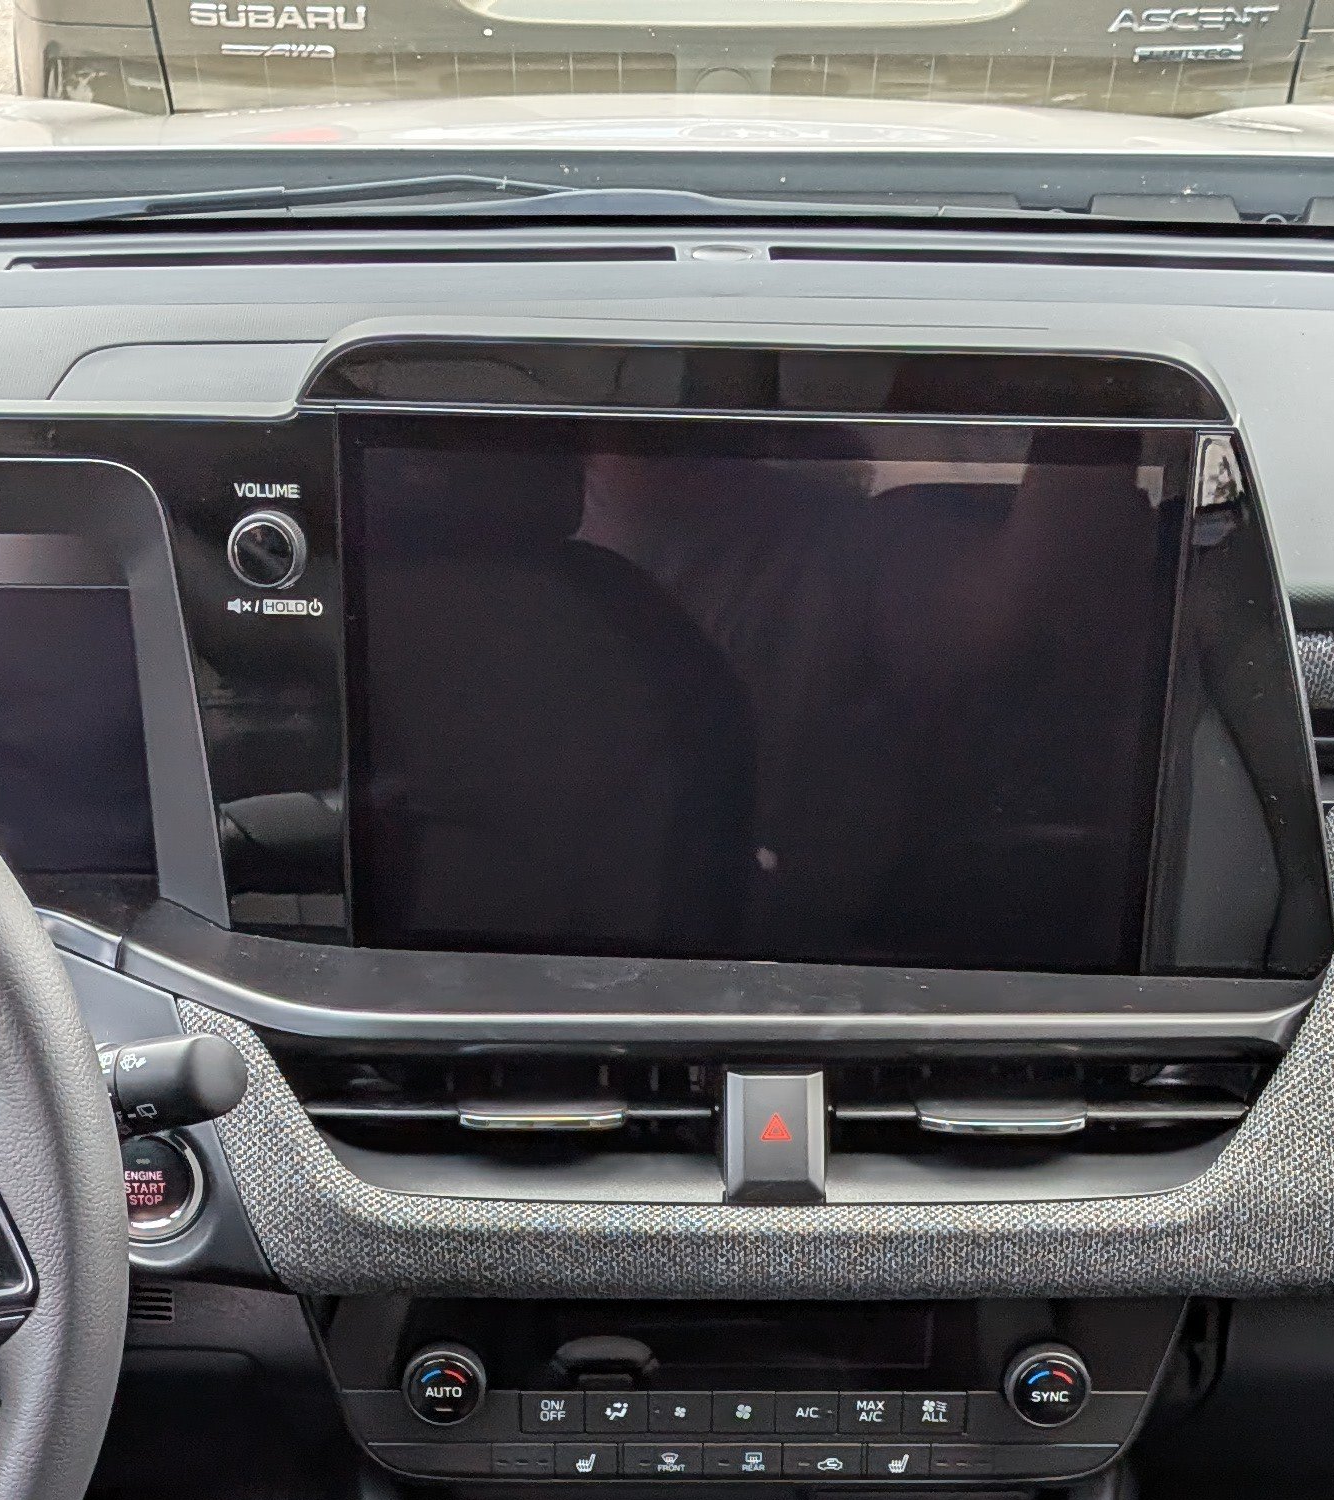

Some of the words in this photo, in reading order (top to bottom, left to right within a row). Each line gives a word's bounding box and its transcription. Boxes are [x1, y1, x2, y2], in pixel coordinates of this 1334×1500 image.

[189, 3, 366, 30] SUBARU
[1108, 5, 1279, 32] ASCENT
[233, 482, 301, 499] VOLUME
[264, 600, 306, 614] HOLD
[124, 1170, 163, 1181] ENGINE
[124, 1182, 166, 1194] START
[129, 1194, 163, 1206] STOP
[425, 1386, 463, 1398] AUTO
[1031, 1390, 1069, 1403] SYNC
[540, 1399, 565, 1411] ON/
[856, 1400, 886, 1411] MAX
[539, 1410, 566, 1422] OFF
[795, 1407, 819, 1418] A/C
[858, 1411, 883, 1423] A/C
[921, 1412, 948, 1423] ALL
[657, 1463, 686, 1472] FRONT
[741, 1463, 766, 1472] REAR
